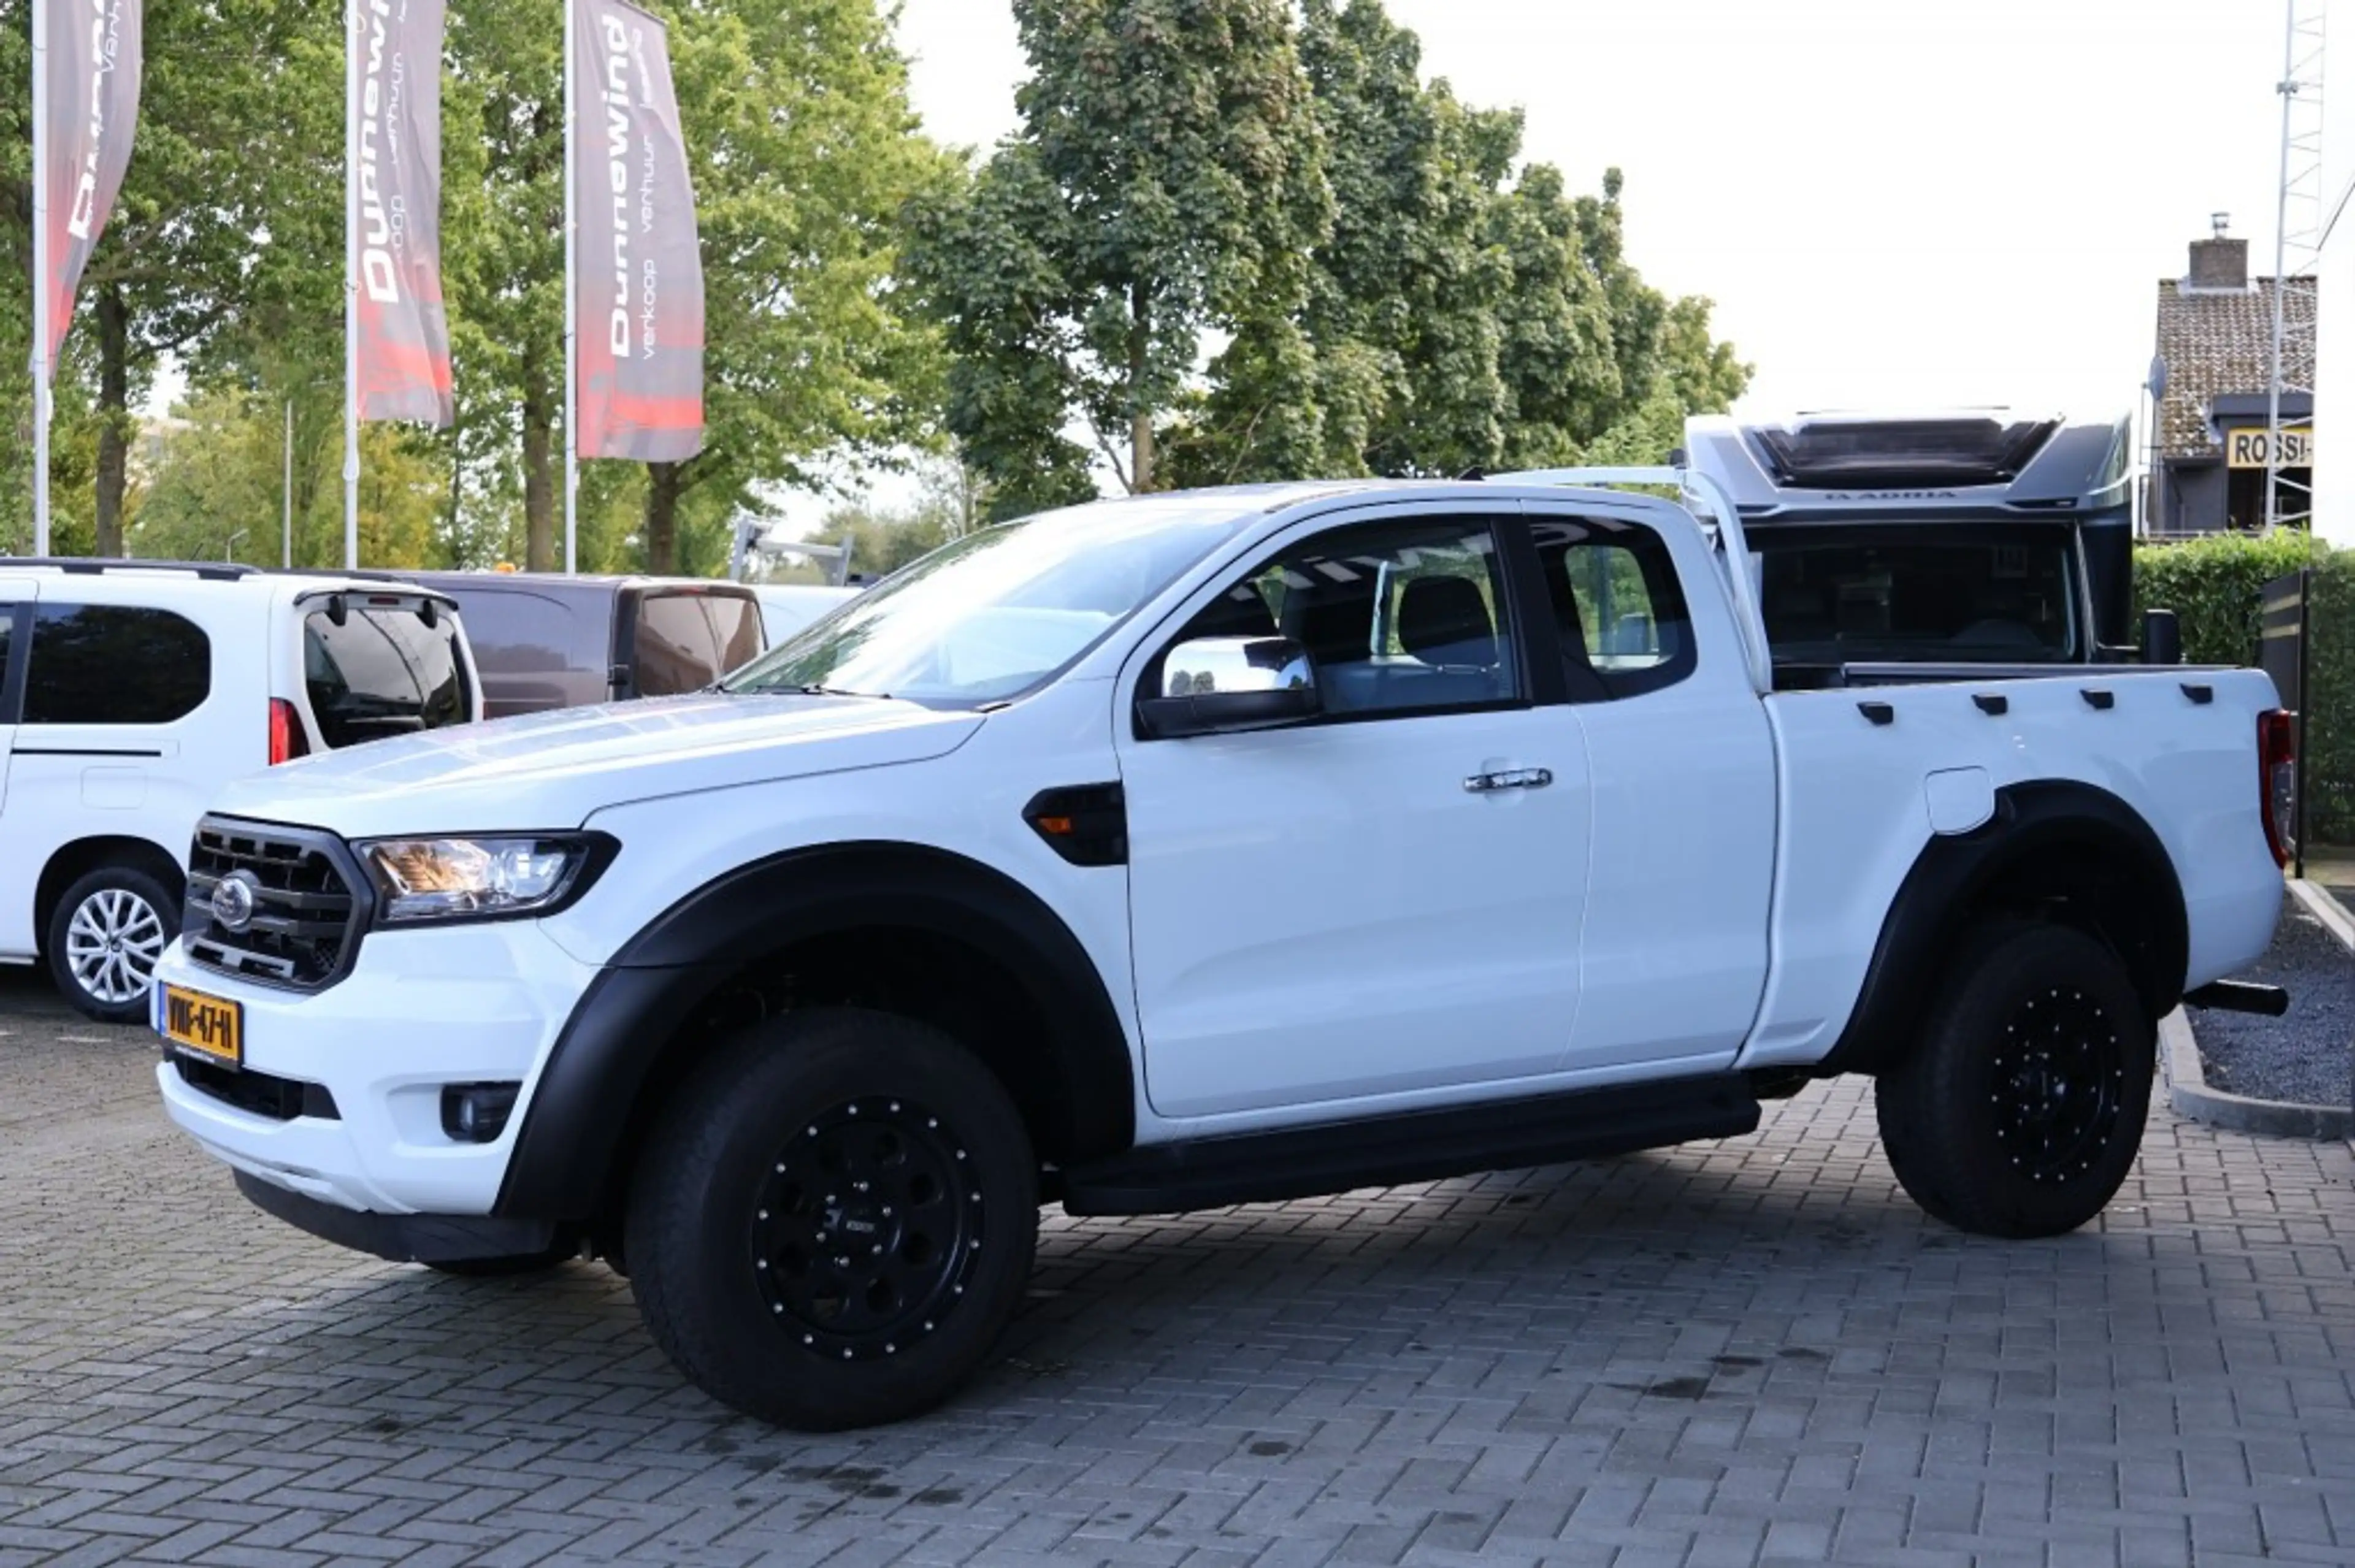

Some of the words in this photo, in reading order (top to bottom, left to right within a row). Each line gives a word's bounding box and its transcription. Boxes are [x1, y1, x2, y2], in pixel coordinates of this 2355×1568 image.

[602, 15, 630, 357] Dunnewind
[639, 134, 656, 233] verhuur
[639, 259, 657, 360] verkoop
